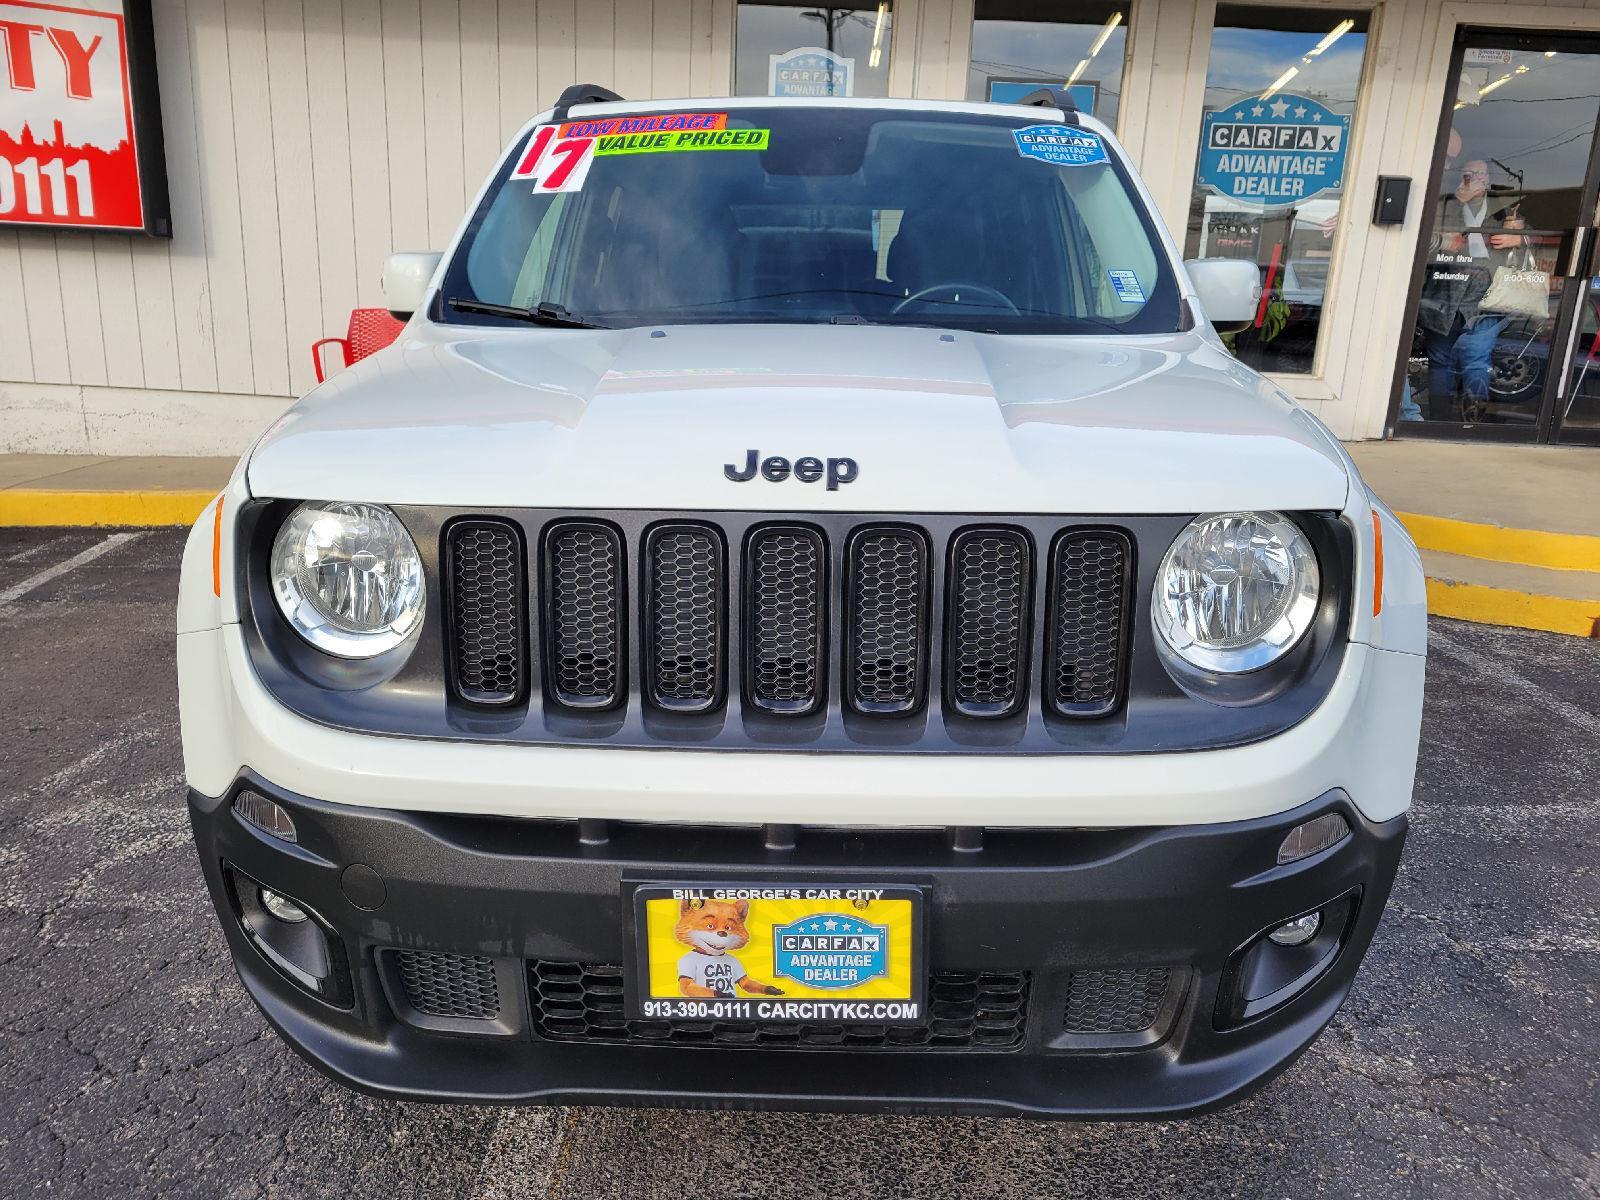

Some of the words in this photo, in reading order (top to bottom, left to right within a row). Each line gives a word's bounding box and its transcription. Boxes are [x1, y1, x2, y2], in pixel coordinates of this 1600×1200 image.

[781, 70, 844, 84] CARFAX
[566, 119, 614, 138] LOW
[618, 113, 720, 134] MILEAGE
[598, 133, 670, 151] VALUE
[676, 129, 764, 148] PRICED
[1022, 134, 1098, 148] CARFAX
[1215, 126, 1337, 151] CARFAX
[1031, 144, 1095, 155] ADVANTAGE
[1045, 152, 1088, 162] DEALER
[1233, 176, 1305, 196] DEALER
[1436, 254, 1454, 263] Mon
[1456, 254, 1473, 263] thru
[1433, 271, 1470, 282] Saturday
[1503, 274, 1545, 284] 9:00-6:00
[724, 449, 859, 491] Jeep
[673, 889, 708, 900] BILL
[713, 889, 800, 900] GEORGE'S
[805, 889, 843, 900] CAR
[846, 889, 884, 900] CITY
[785, 936, 876, 951] CARFAX
[790, 954, 872, 967] ADVANTAGE
[704, 964, 732, 978] CAR
[804, 968, 858, 981] DEALER
[705, 977, 734, 992] FOX
[644, 1001, 750, 1018] 913-390-0111
[757, 1003, 918, 1019] CARCITYKC.COM
